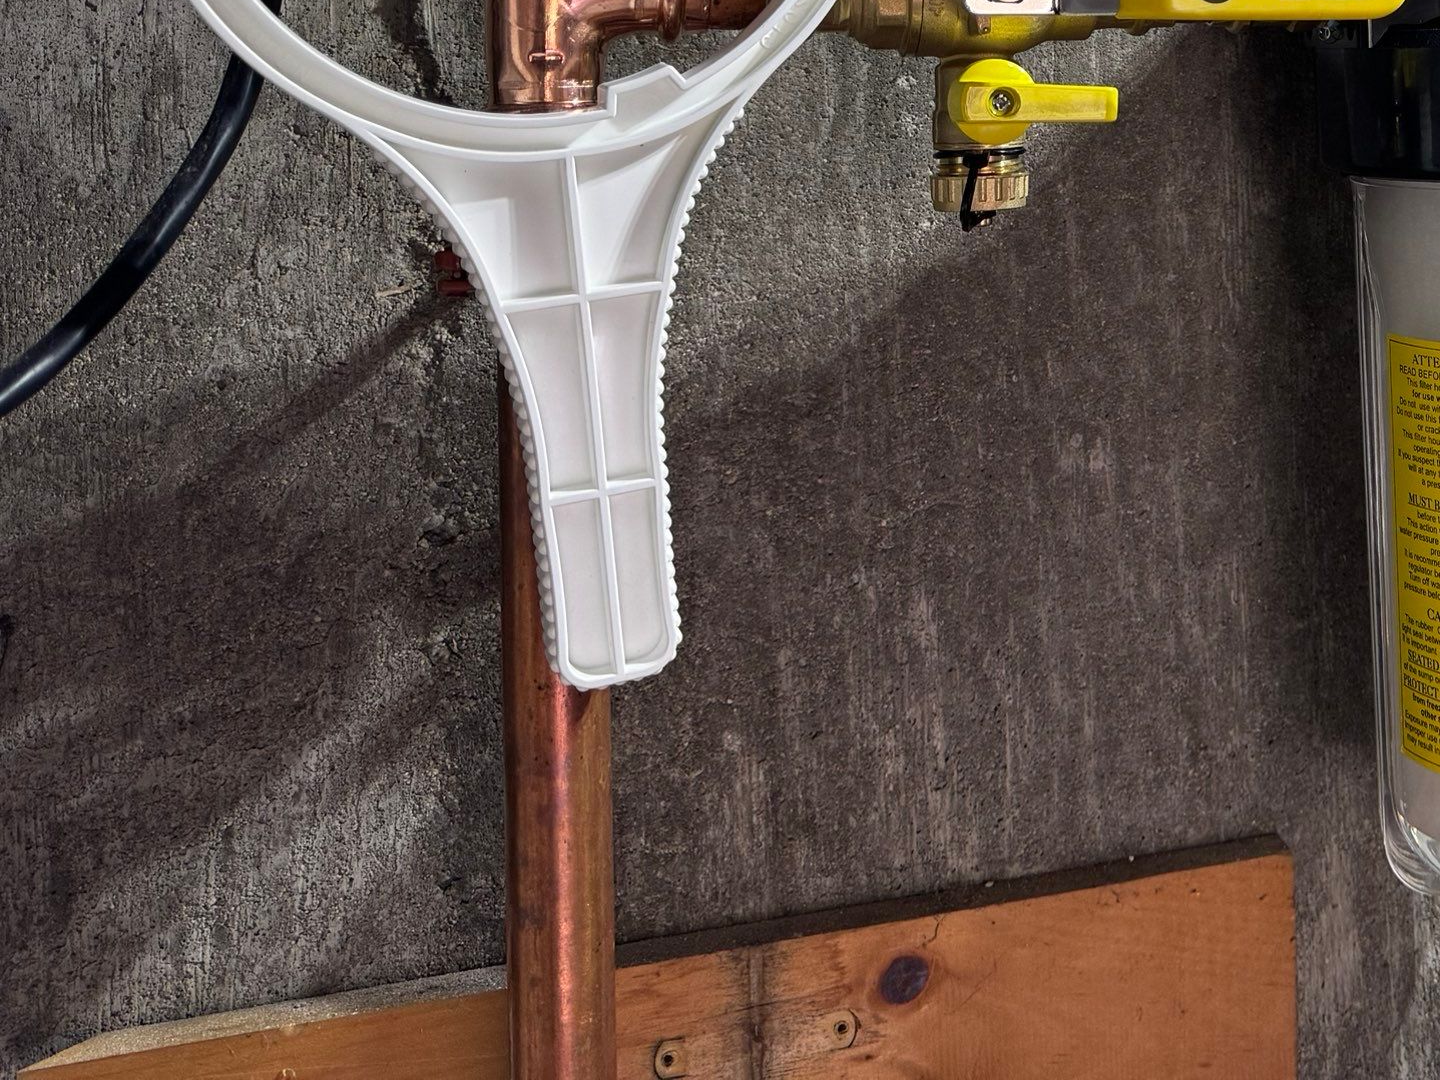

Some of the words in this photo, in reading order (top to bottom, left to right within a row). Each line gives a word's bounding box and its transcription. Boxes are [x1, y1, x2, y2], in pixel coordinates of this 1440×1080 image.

[1399, 364, 1417, 377] READ
[1412, 389, 1421, 398] for
[1422, 393, 1435, 401] use
[1419, 403, 1431, 411] use
[1408, 492, 1433, 511] MUST
[1407, 649, 1440, 671] SEATED
[1403, 673, 1440, 699] PROTECT
[1420, 708, 1437, 721] other
